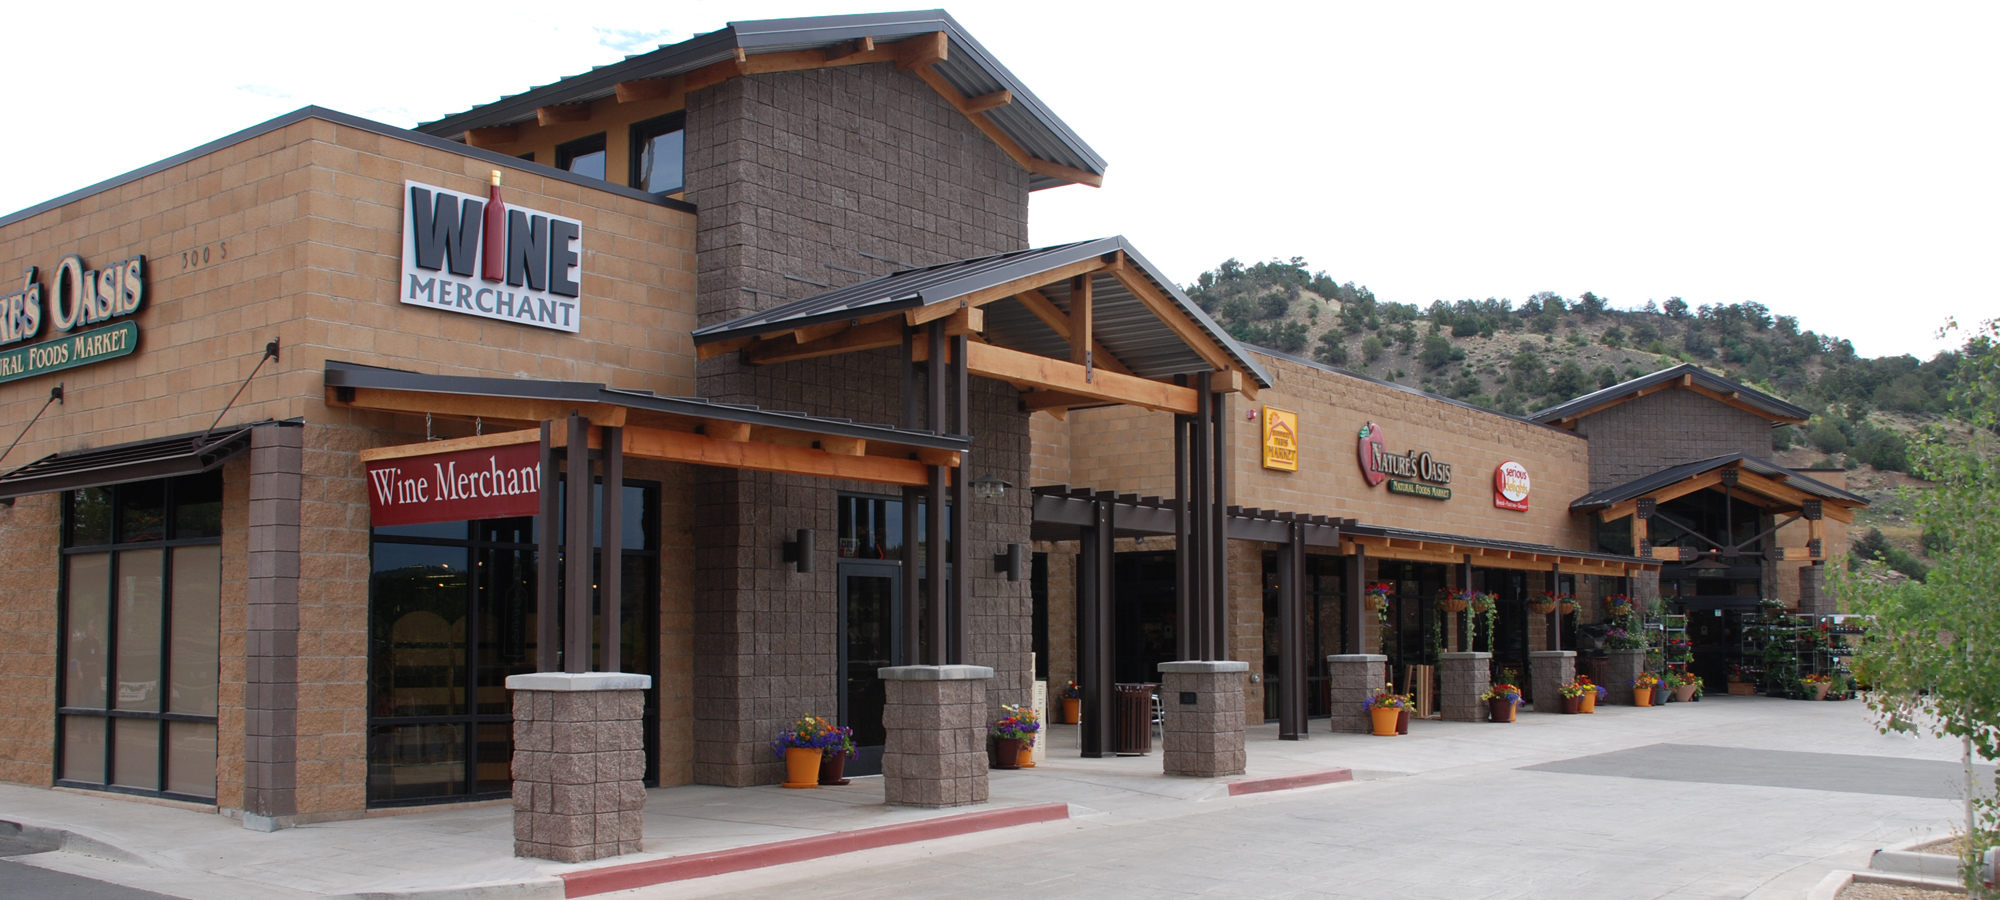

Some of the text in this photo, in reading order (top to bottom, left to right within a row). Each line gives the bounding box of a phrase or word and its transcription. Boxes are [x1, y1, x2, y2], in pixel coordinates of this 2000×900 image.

[51, 253, 145, 332] OASIS
[409, 273, 575, 326] MERCHANT
[29, 344, 69, 371] FOODS
[73, 328, 128, 361] MARKET
[370, 467, 429, 506] Wine
[1420, 452, 1451, 484] OASIS
